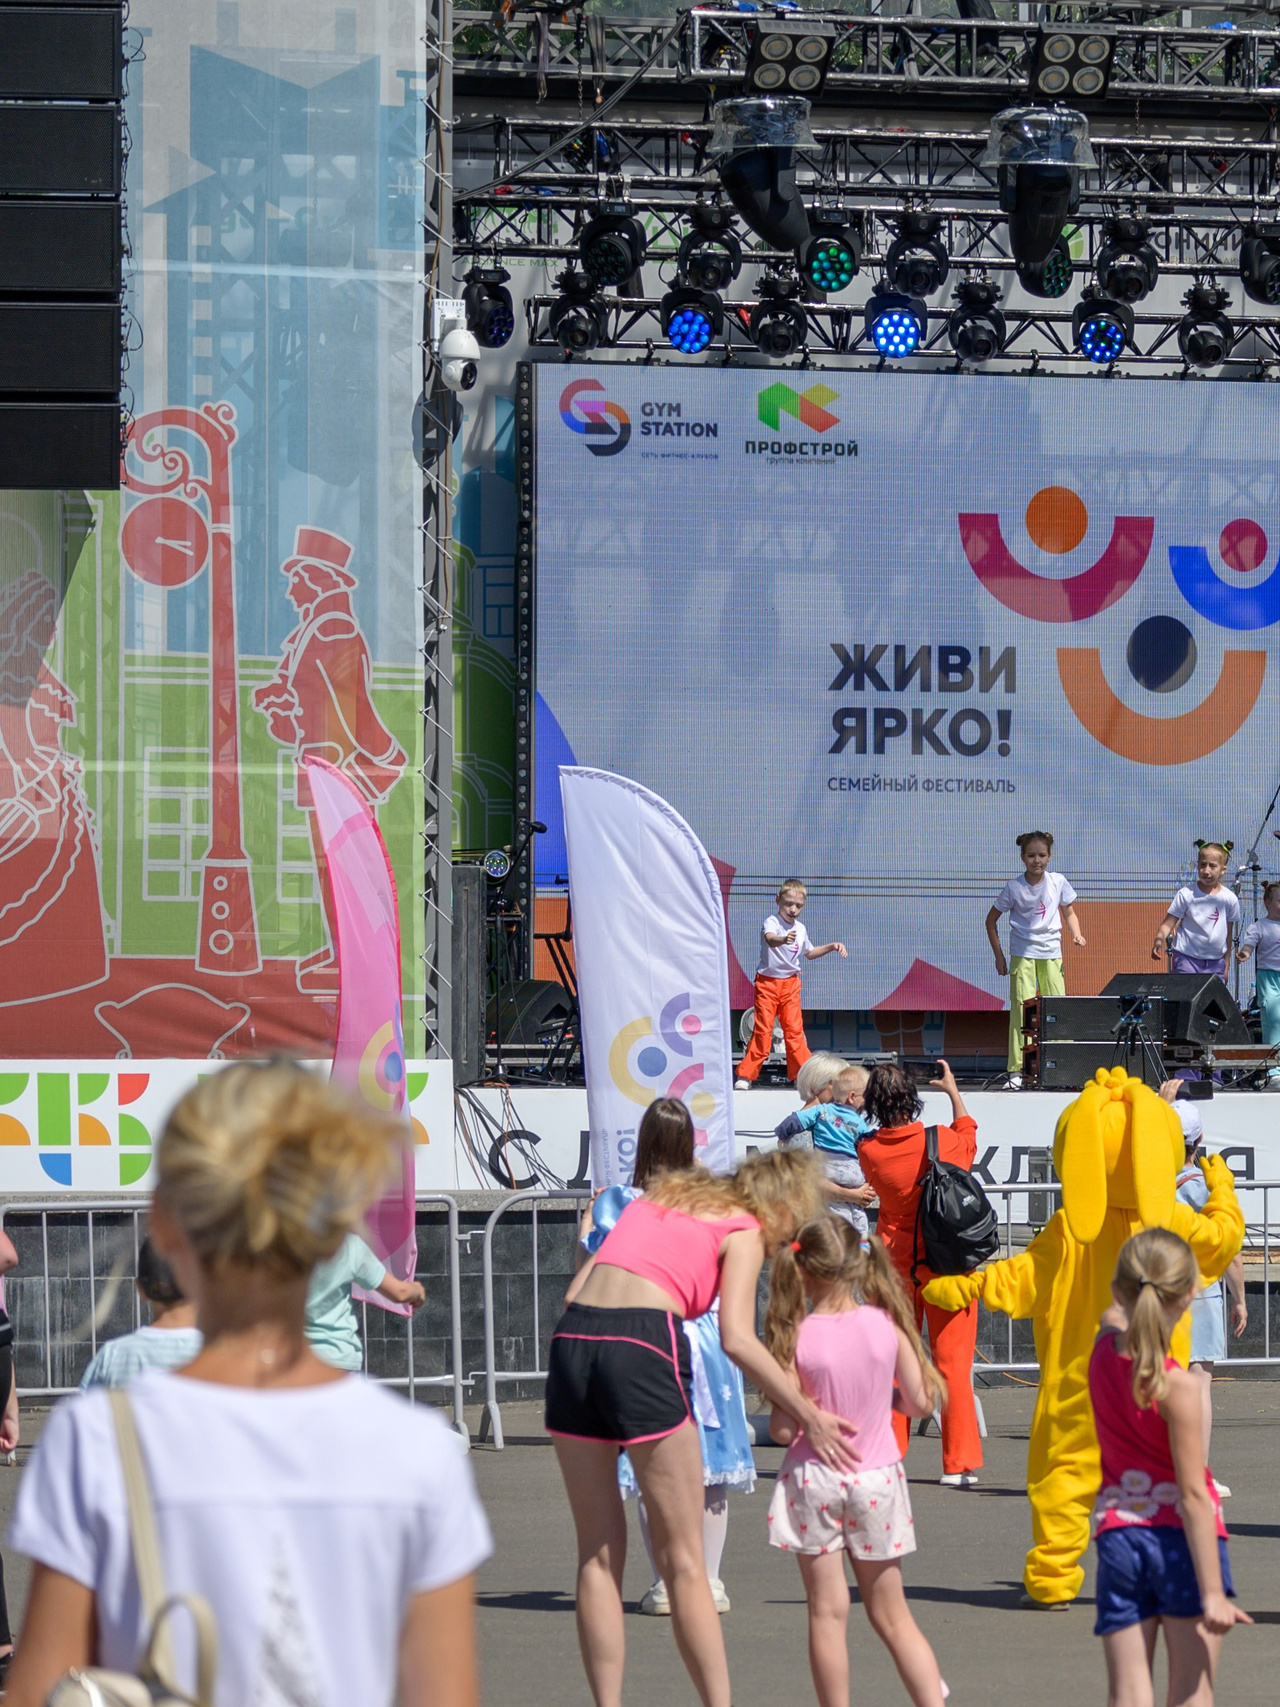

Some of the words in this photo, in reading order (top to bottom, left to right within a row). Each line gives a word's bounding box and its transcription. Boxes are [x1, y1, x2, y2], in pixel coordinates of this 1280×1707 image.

[534, 258, 559, 268] MAX
[641, 402, 682, 418] GYM
[640, 422, 718, 439] STATION
[745, 440, 859, 457] ПРОФСТРОЙ
[827, 643, 1017, 694] ЖИВИ
[827, 707, 1012, 757] ЯРКО!
[827, 774, 919, 792] СЕМЕЙНЫЙ
[921, 778, 1016, 793] ФЕСТИВАЛЬ
